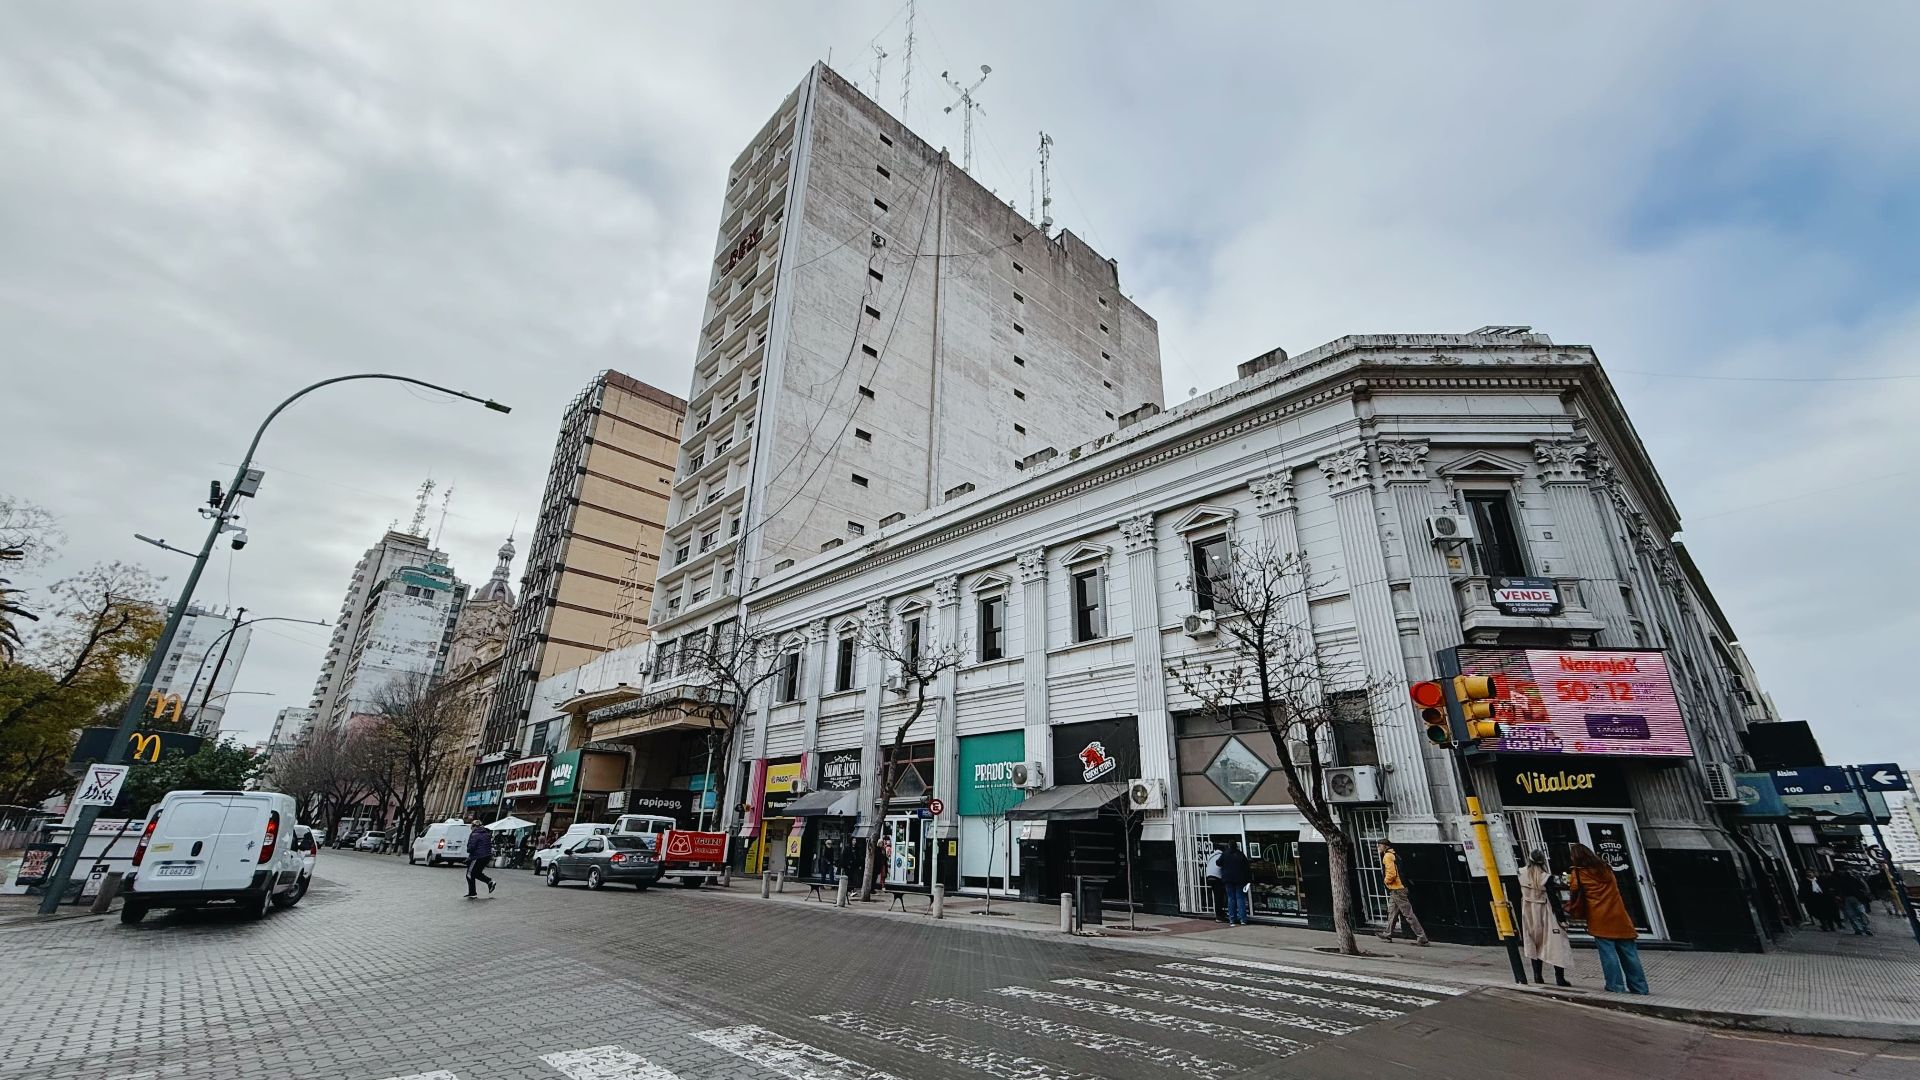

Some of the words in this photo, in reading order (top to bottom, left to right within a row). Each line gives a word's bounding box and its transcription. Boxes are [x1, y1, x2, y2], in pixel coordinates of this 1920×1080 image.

[1500, 590, 1552, 601] VENDE
[1556, 680, 1589, 702] 50
[1605, 681, 1634, 701] 12
[507, 761, 546, 781] HENRY
[975, 761, 1012, 781] PRADO'S
[1776, 769, 1798, 777] Alsina
[1516, 770, 1595, 794] Vitalcer
[639, 797, 682, 810] rapipago
